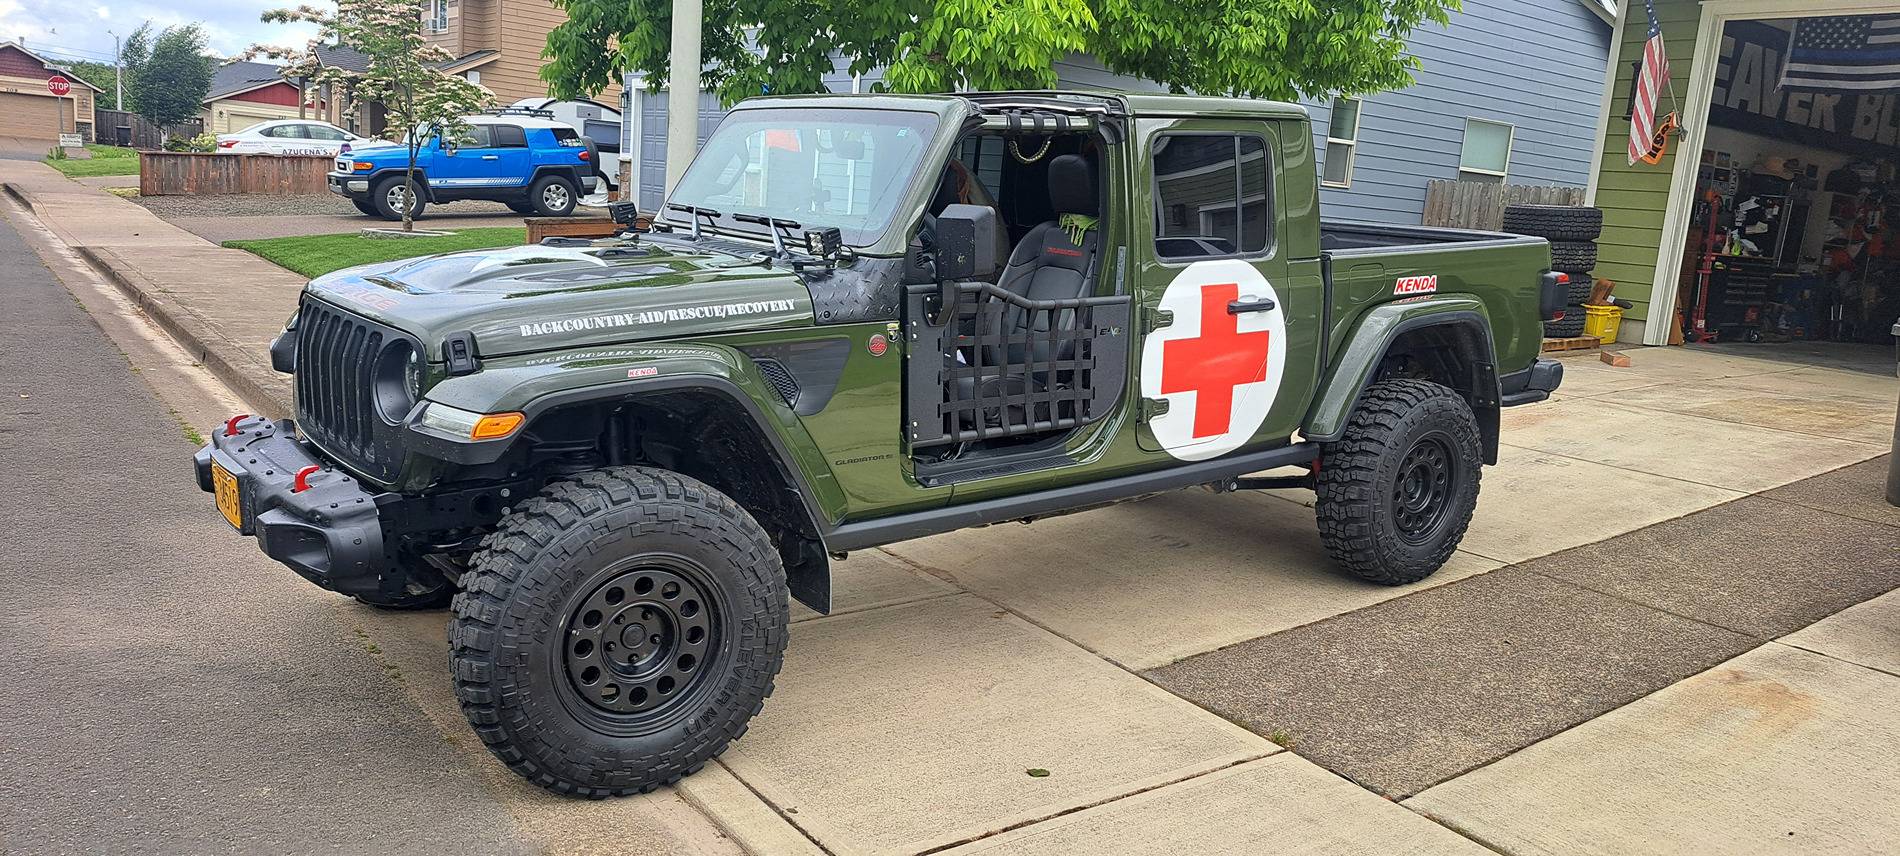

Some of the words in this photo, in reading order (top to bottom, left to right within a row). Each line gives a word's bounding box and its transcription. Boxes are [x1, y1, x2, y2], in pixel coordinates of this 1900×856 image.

[49, 81, 69, 91] STOP
[282, 148, 329, 156] AZUCENA'S
[1395, 276, 1437, 293] KENDA
[628, 367, 658, 377] KENDA
[835, 454, 884, 466] GLADIATOR
